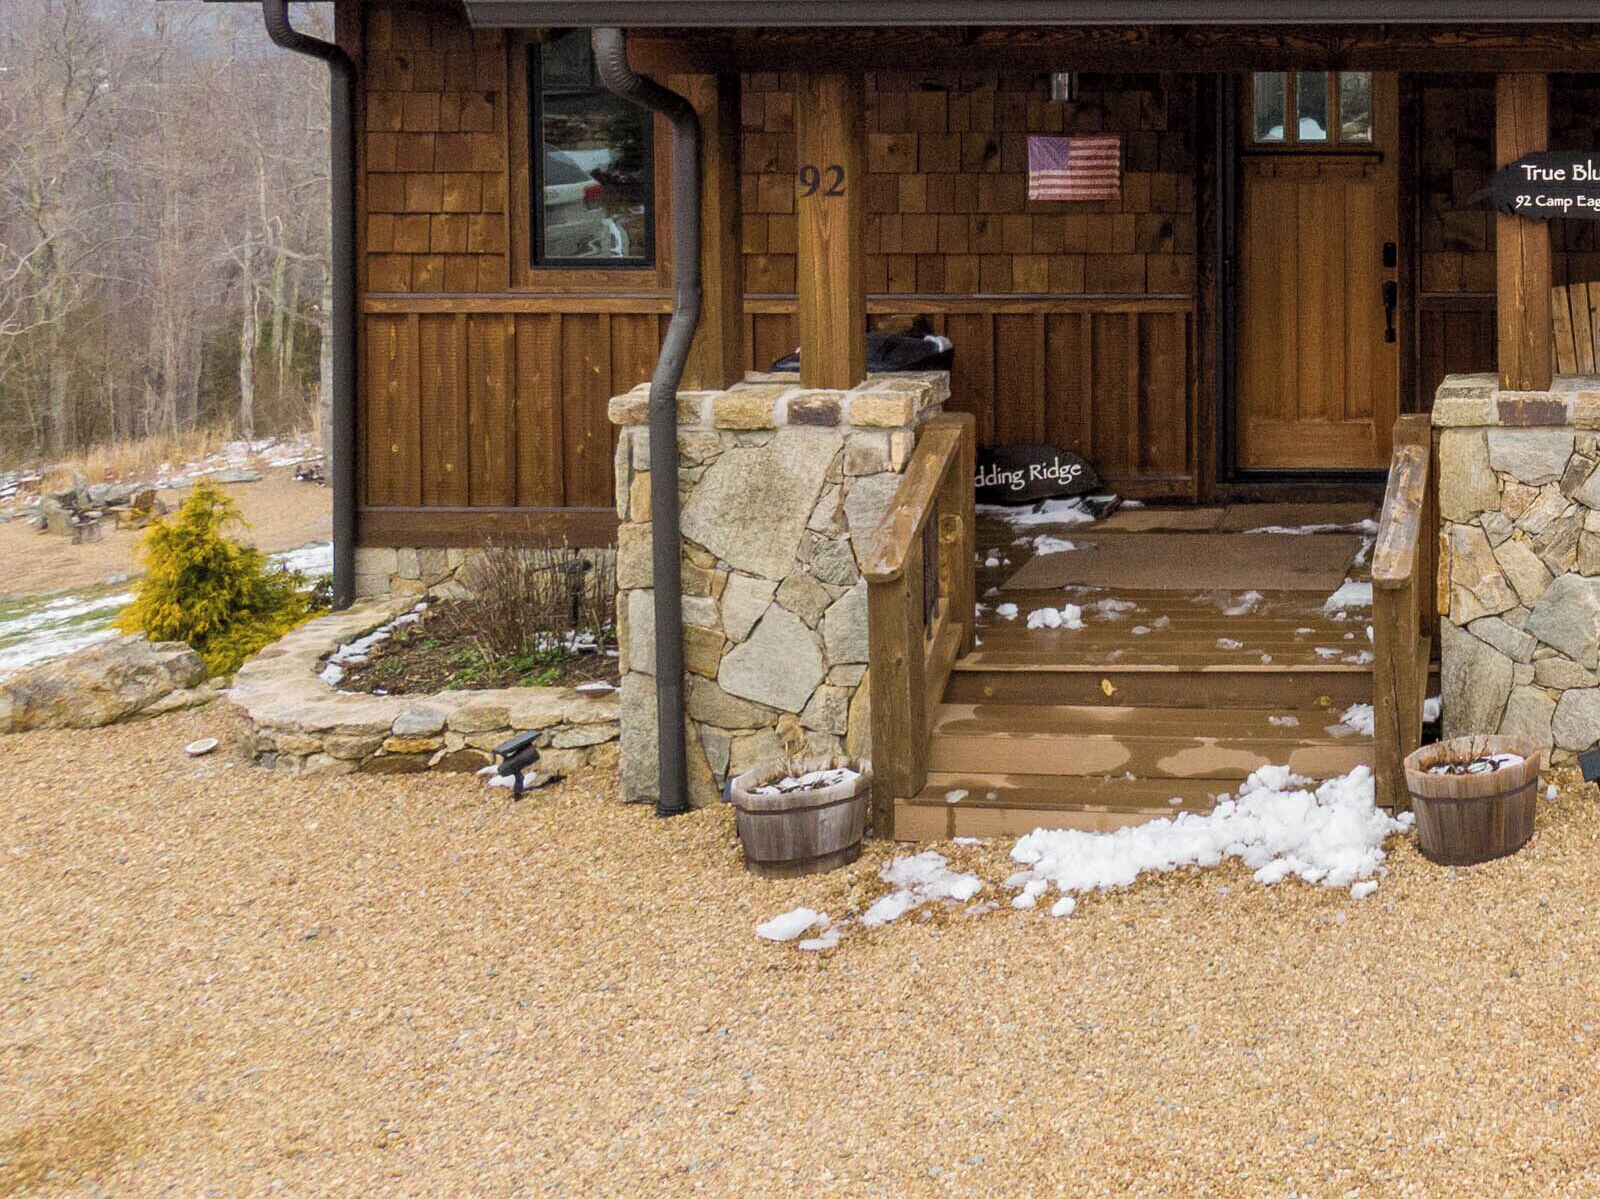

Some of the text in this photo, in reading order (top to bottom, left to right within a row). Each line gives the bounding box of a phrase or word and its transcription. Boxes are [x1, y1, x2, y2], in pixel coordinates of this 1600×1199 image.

[799, 164, 845, 197] 92
[1521, 164, 1566, 181] True
[1515, 195, 1532, 209] 92
[1535, 195, 1573, 213] Camp
[974, 456, 1082, 490] dding Ridge
